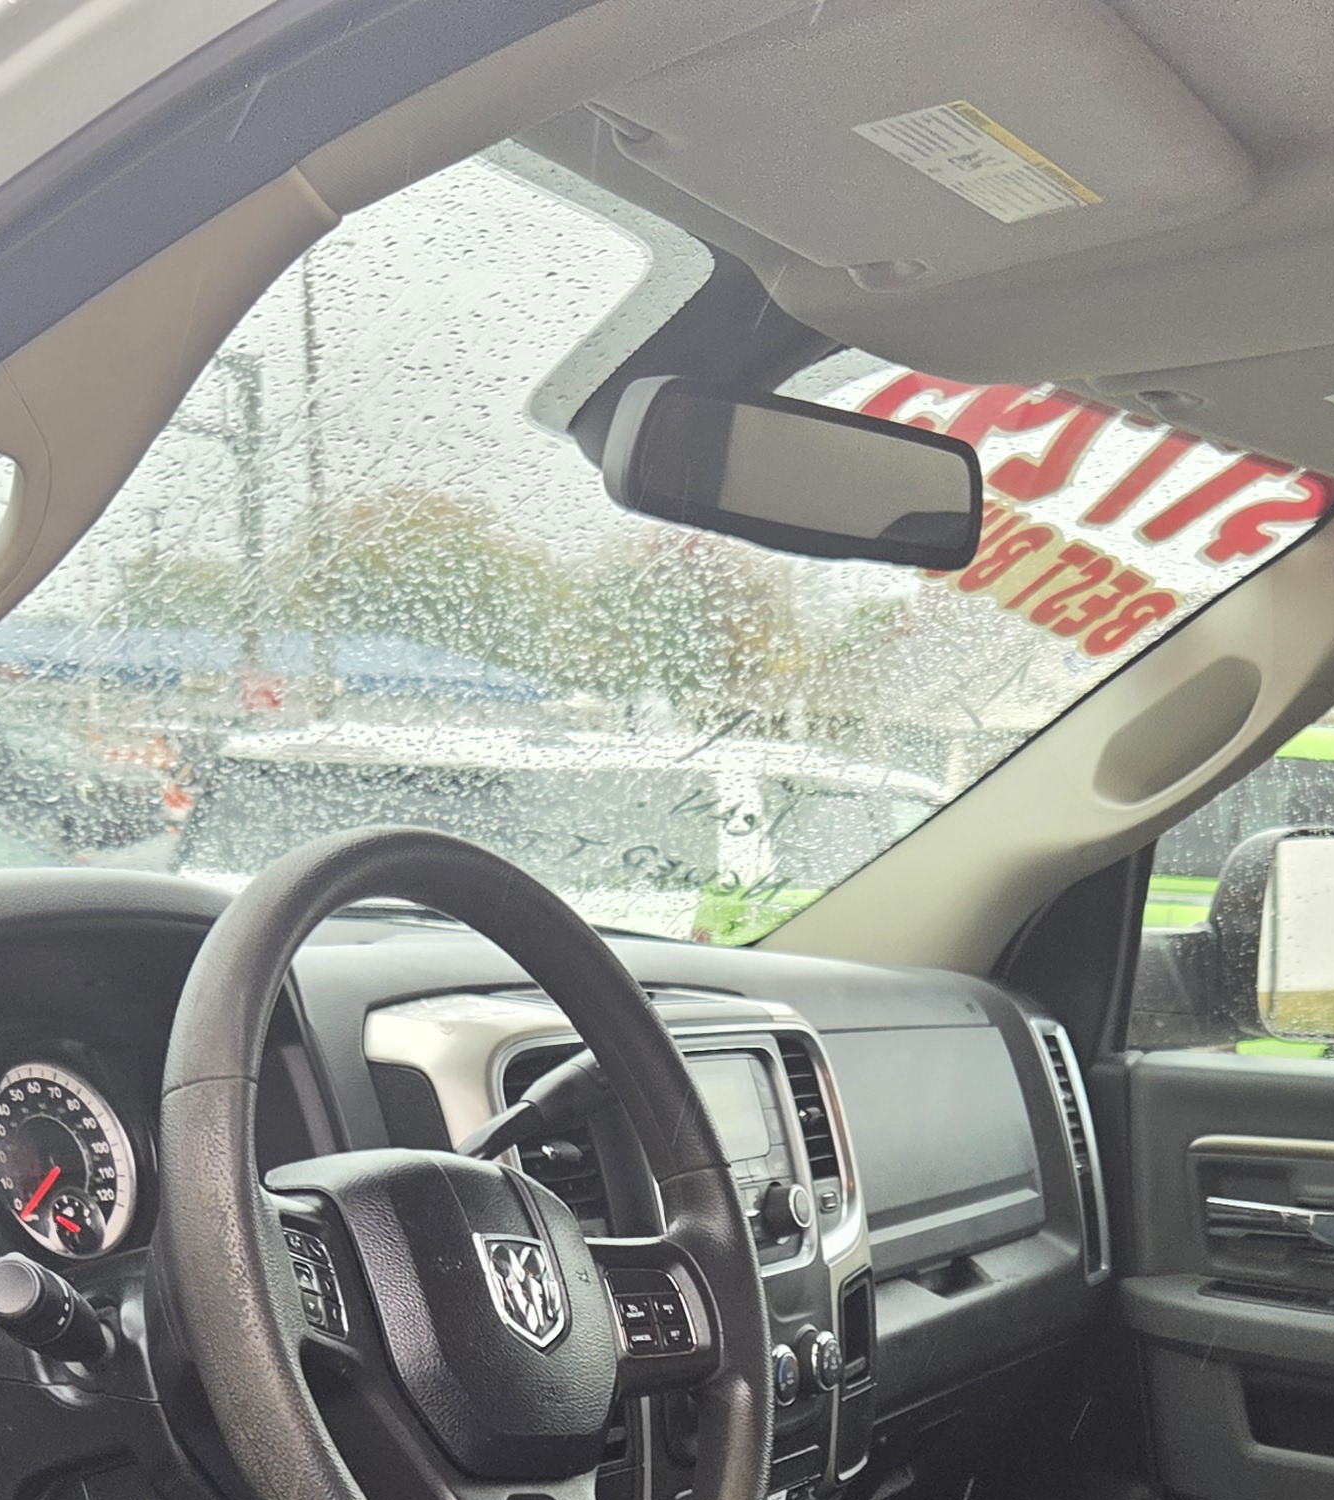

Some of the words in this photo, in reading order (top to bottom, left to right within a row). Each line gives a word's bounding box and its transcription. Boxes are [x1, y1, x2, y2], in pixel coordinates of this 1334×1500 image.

[27, 1081, 42, 1094] 60
[47, 1086, 62, 1099] 70
[9, 1089, 25, 1102] 50
[66, 1098, 81, 1112] 80
[82, 1117, 97, 1129] 90
[91, 1141, 110, 1154] 100
[98, 1166, 115, 1179] 110
[0, 1176, 14, 1190] 10
[96, 1188, 115, 1201] 120
[13, 1197, 23, 1211] 0
